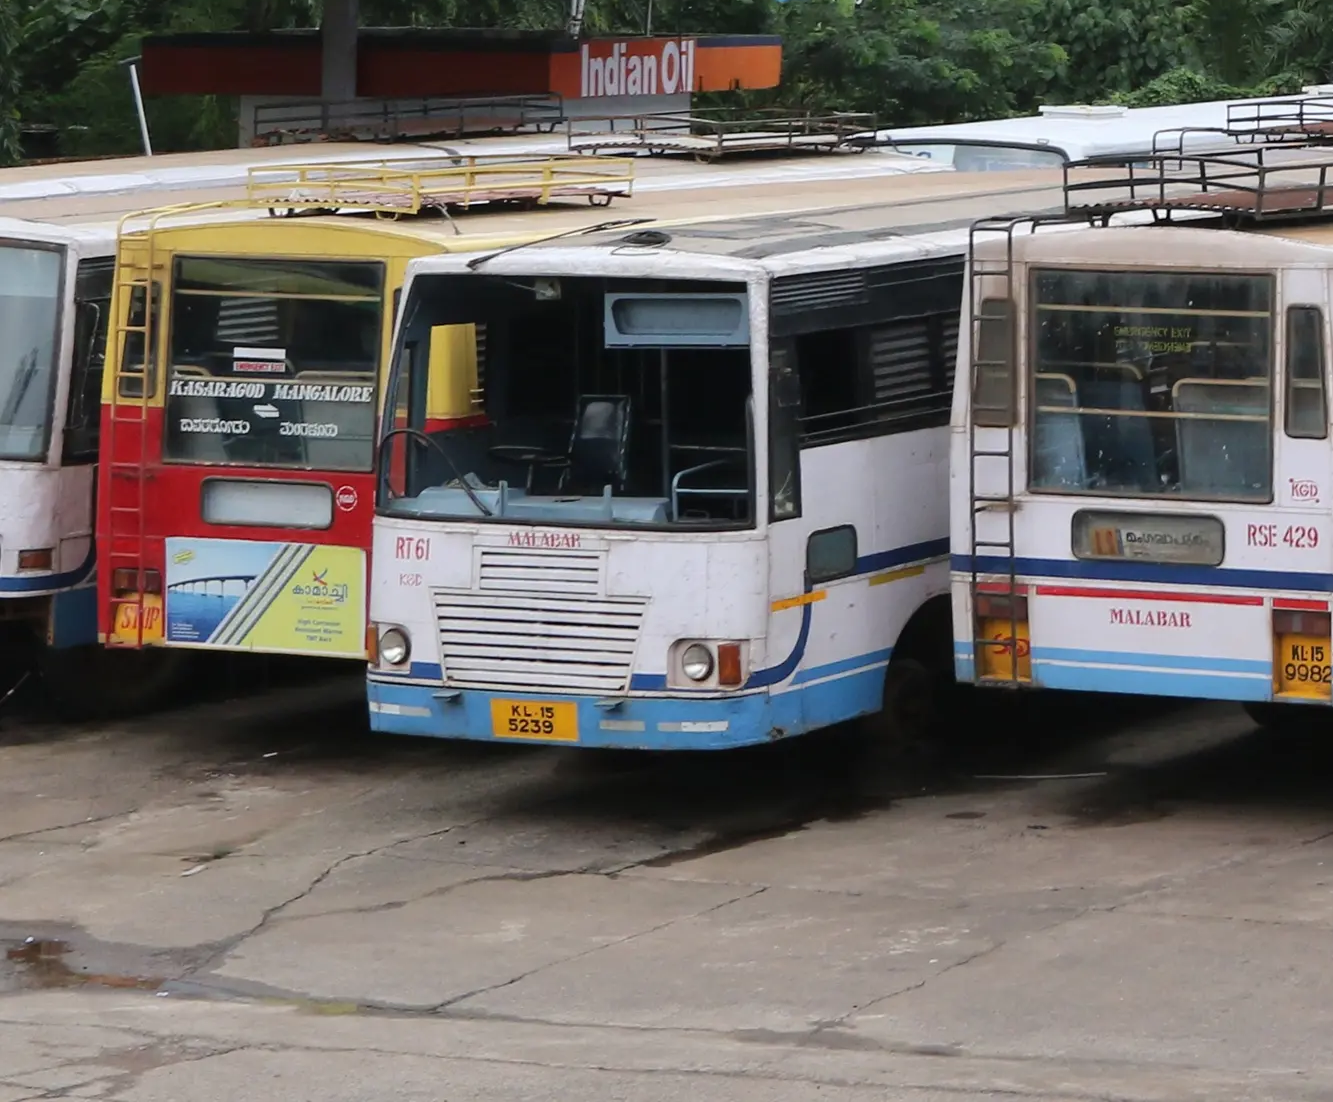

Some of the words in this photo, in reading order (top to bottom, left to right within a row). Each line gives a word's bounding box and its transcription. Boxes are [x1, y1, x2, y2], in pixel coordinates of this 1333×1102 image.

[581, 42, 658, 97] Indian
[661, 40, 694, 94] Oil
[169, 380, 265, 399] KASARAGOD
[272, 384, 373, 402] MANGALORE
[1291, 483, 1319, 498] KGD
[507, 531, 581, 548] MALABAR
[1247, 523, 1277, 547] RSE
[1283, 525, 1319, 548] 429
[1110, 608, 1192, 628] MALABAR
[1284, 662, 1332, 684] 9982
[508, 718, 554, 735] 5239
